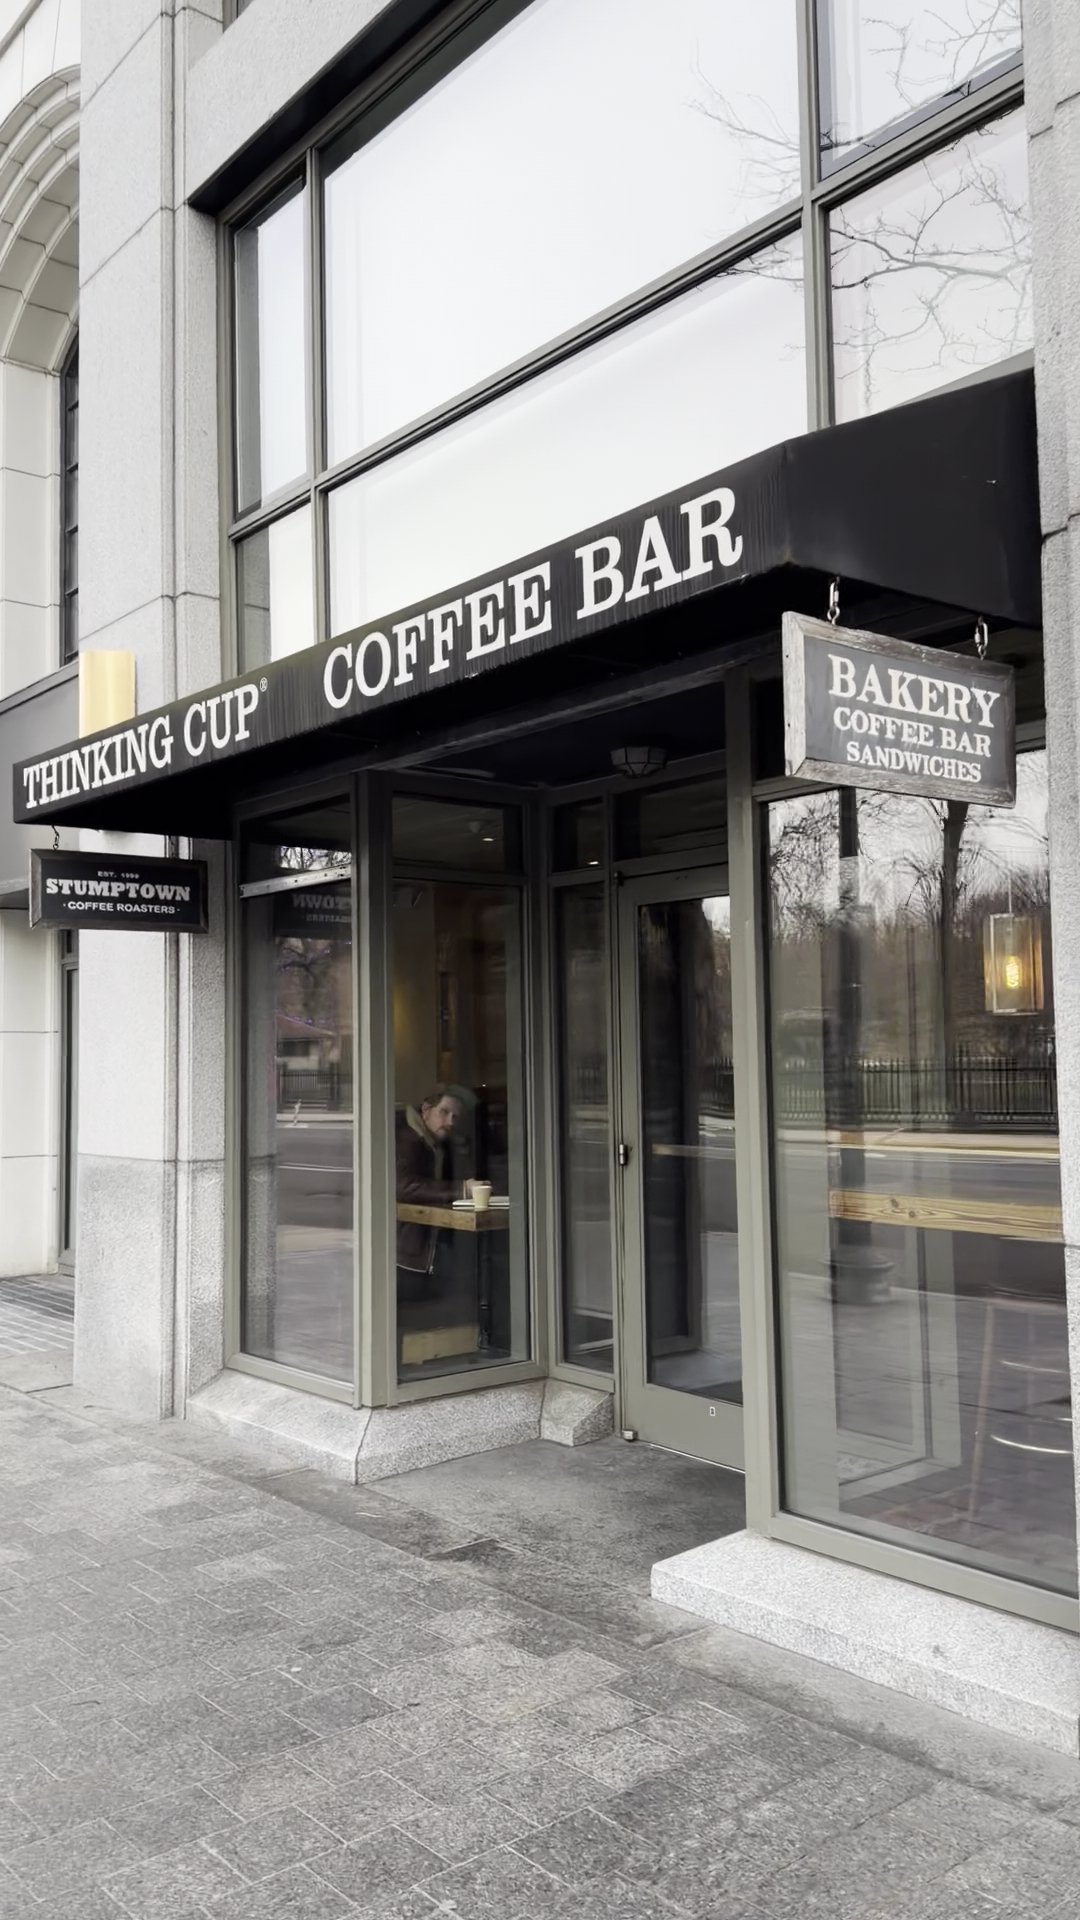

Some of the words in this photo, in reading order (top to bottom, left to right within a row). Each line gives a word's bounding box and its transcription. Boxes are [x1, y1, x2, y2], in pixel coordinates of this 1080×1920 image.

[23, 715, 174, 809] THINKING
[323, 561, 553, 710] COFFEE
[574, 487, 744, 620] BAR
[828, 654, 1001, 728] BAKERY
[833, 707, 934, 745] COFFEE
[940, 727, 992, 757] BAR
[846, 742, 982, 783] SANDWICHES
[46, 878, 191, 901] STUMPTOWN
[67, 901, 114, 912] COFFEE
[116, 904, 176, 914] ROASTERS
